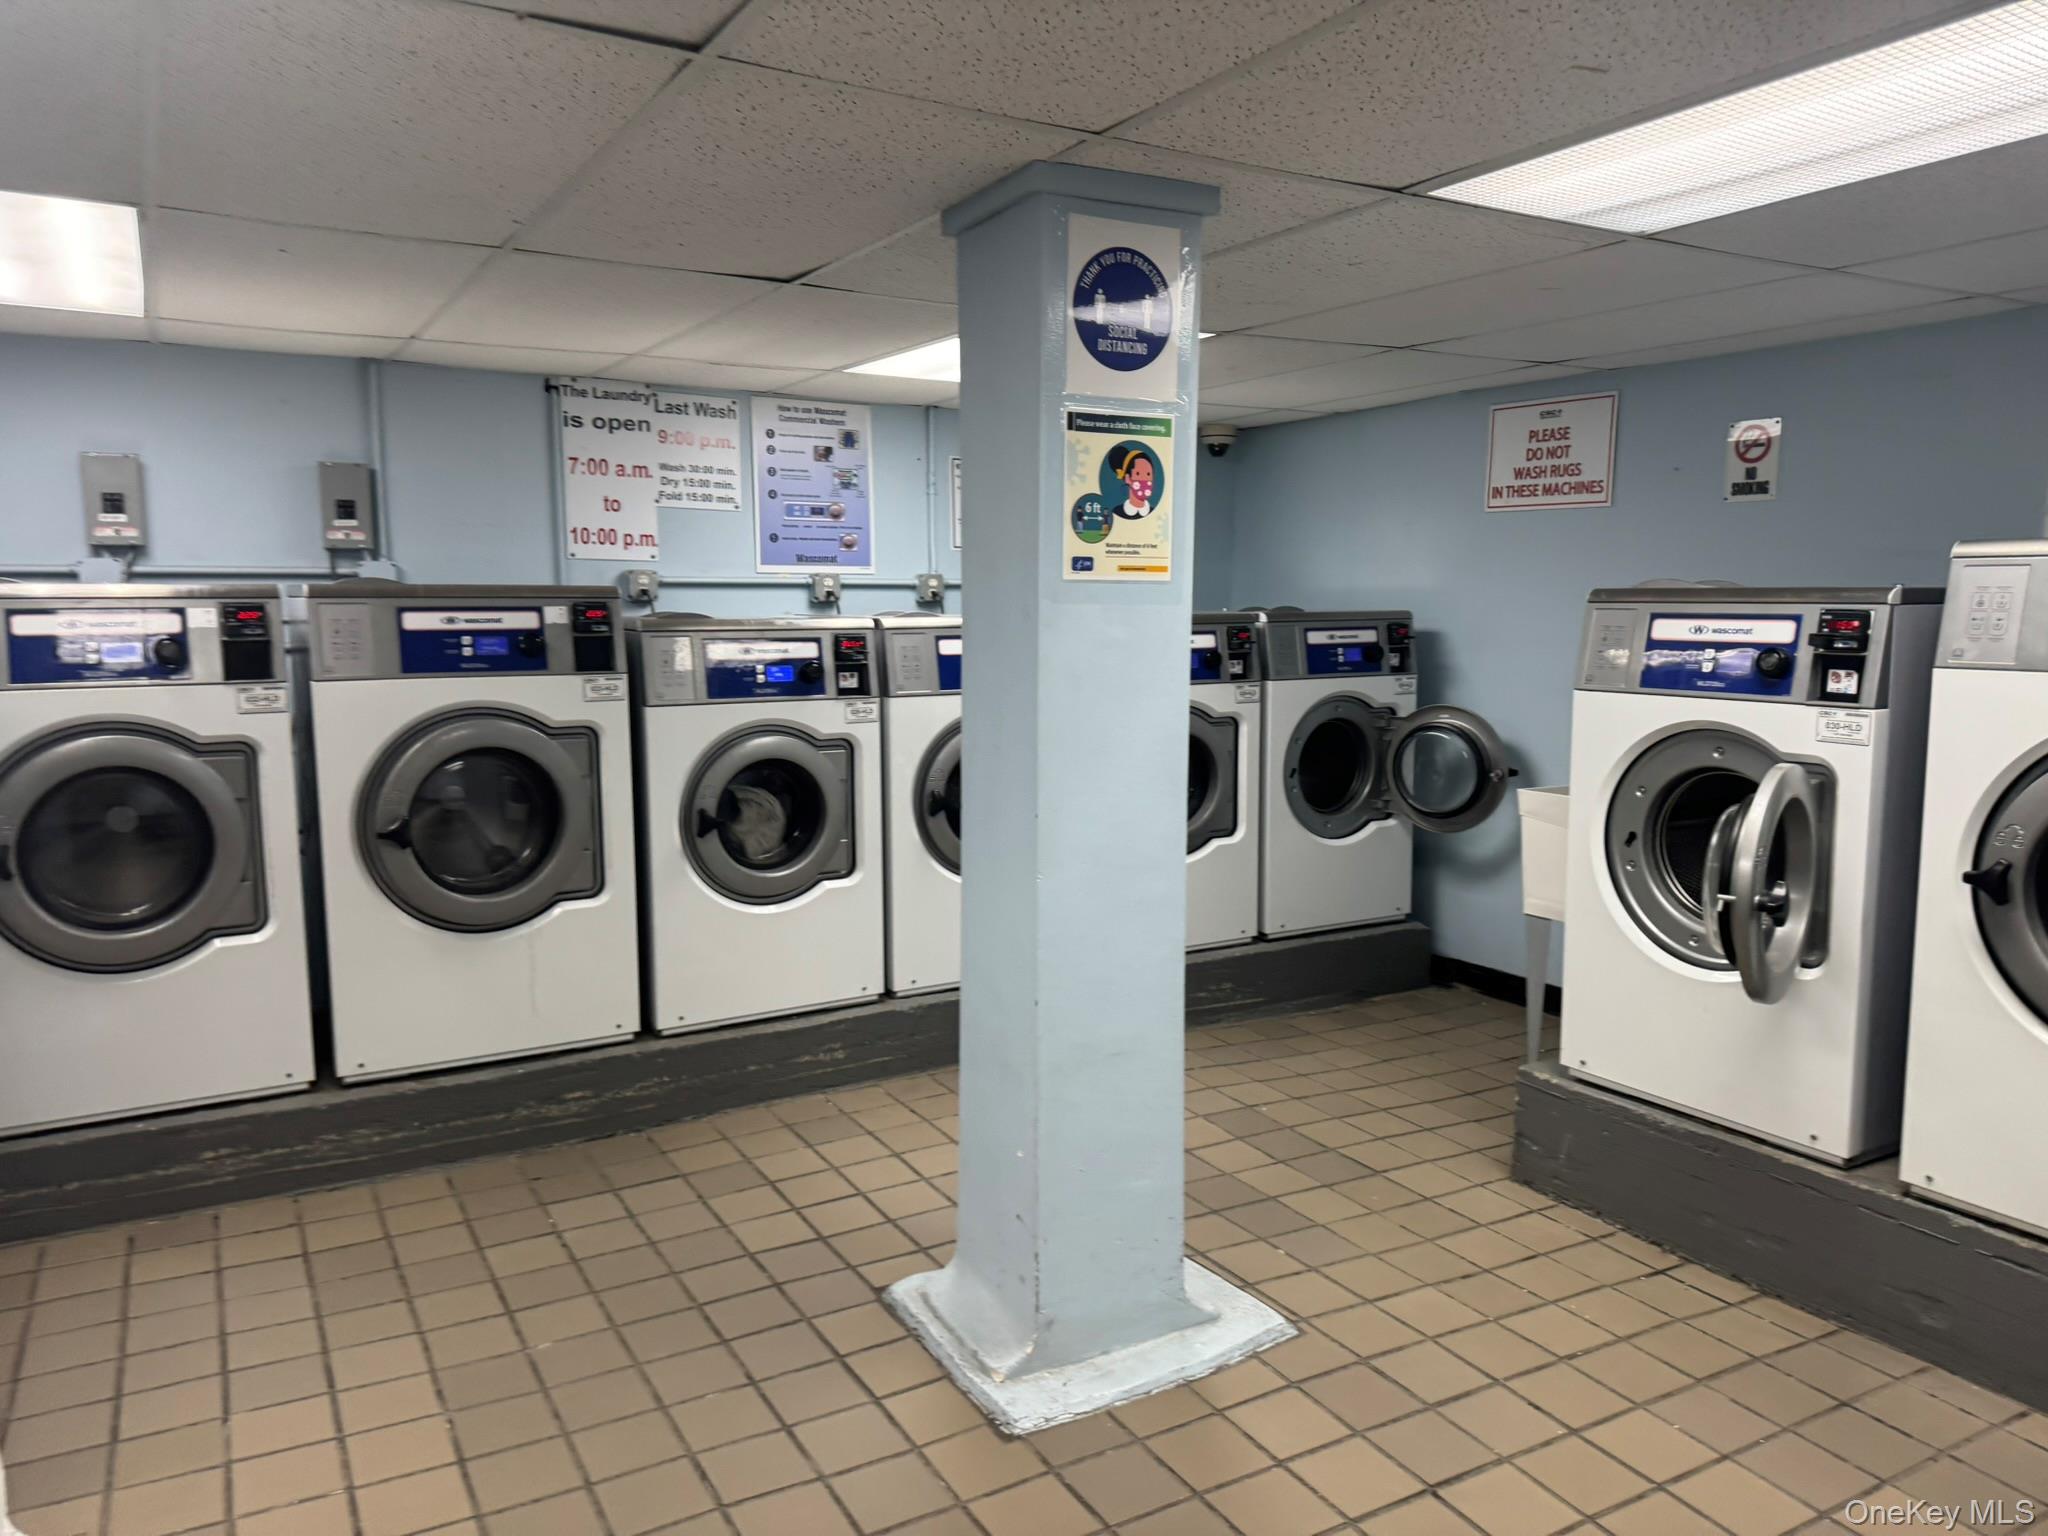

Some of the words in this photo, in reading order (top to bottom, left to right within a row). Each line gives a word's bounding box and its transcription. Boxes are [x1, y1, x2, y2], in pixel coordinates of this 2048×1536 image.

[1080, 261, 1103, 289] THANK
[1100, 253, 1116, 267] YOU
[1117, 252, 1132, 264] FOR
[1108, 324, 1138, 340] SOCIAL
[1098, 339, 1148, 355] DISTANCING
[560, 384, 588, 399] The
[593, 387, 650, 405] Laundry
[654, 398, 689, 416] Last
[693, 401, 736, 419] Wash
[563, 410, 583, 428] is
[592, 416, 651, 434] open
[657, 429, 694, 447] 9:00
[699, 435, 736, 450] p.m.
[1529, 426, 1571, 443] PLEASE
[1526, 447, 1543, 461] DO
[1546, 445, 1571, 460] NOT
[568, 457, 609, 476] 7:00
[615, 463, 653, 478] a.m.
[658, 463, 687, 472] Wash
[1513, 465, 1547, 480] WASH
[1550, 462, 1582, 478] RUGS
[660, 476, 679, 488] Dry
[683, 478, 711, 488] 15:00
[1491, 486, 1503, 499] IN
[1505, 484, 1539, 498] THESE
[1542, 480, 1604, 496] MACHINES
[603, 496, 621, 512] to
[658, 490, 684, 501] Fold
[1085, 502, 1092, 513] 6
[1093, 502, 1102, 513] ft
[570, 527, 617, 545] 10:00
[623, 533, 659, 549] p.m.
[1712, 627, 1753, 635] wascomat
